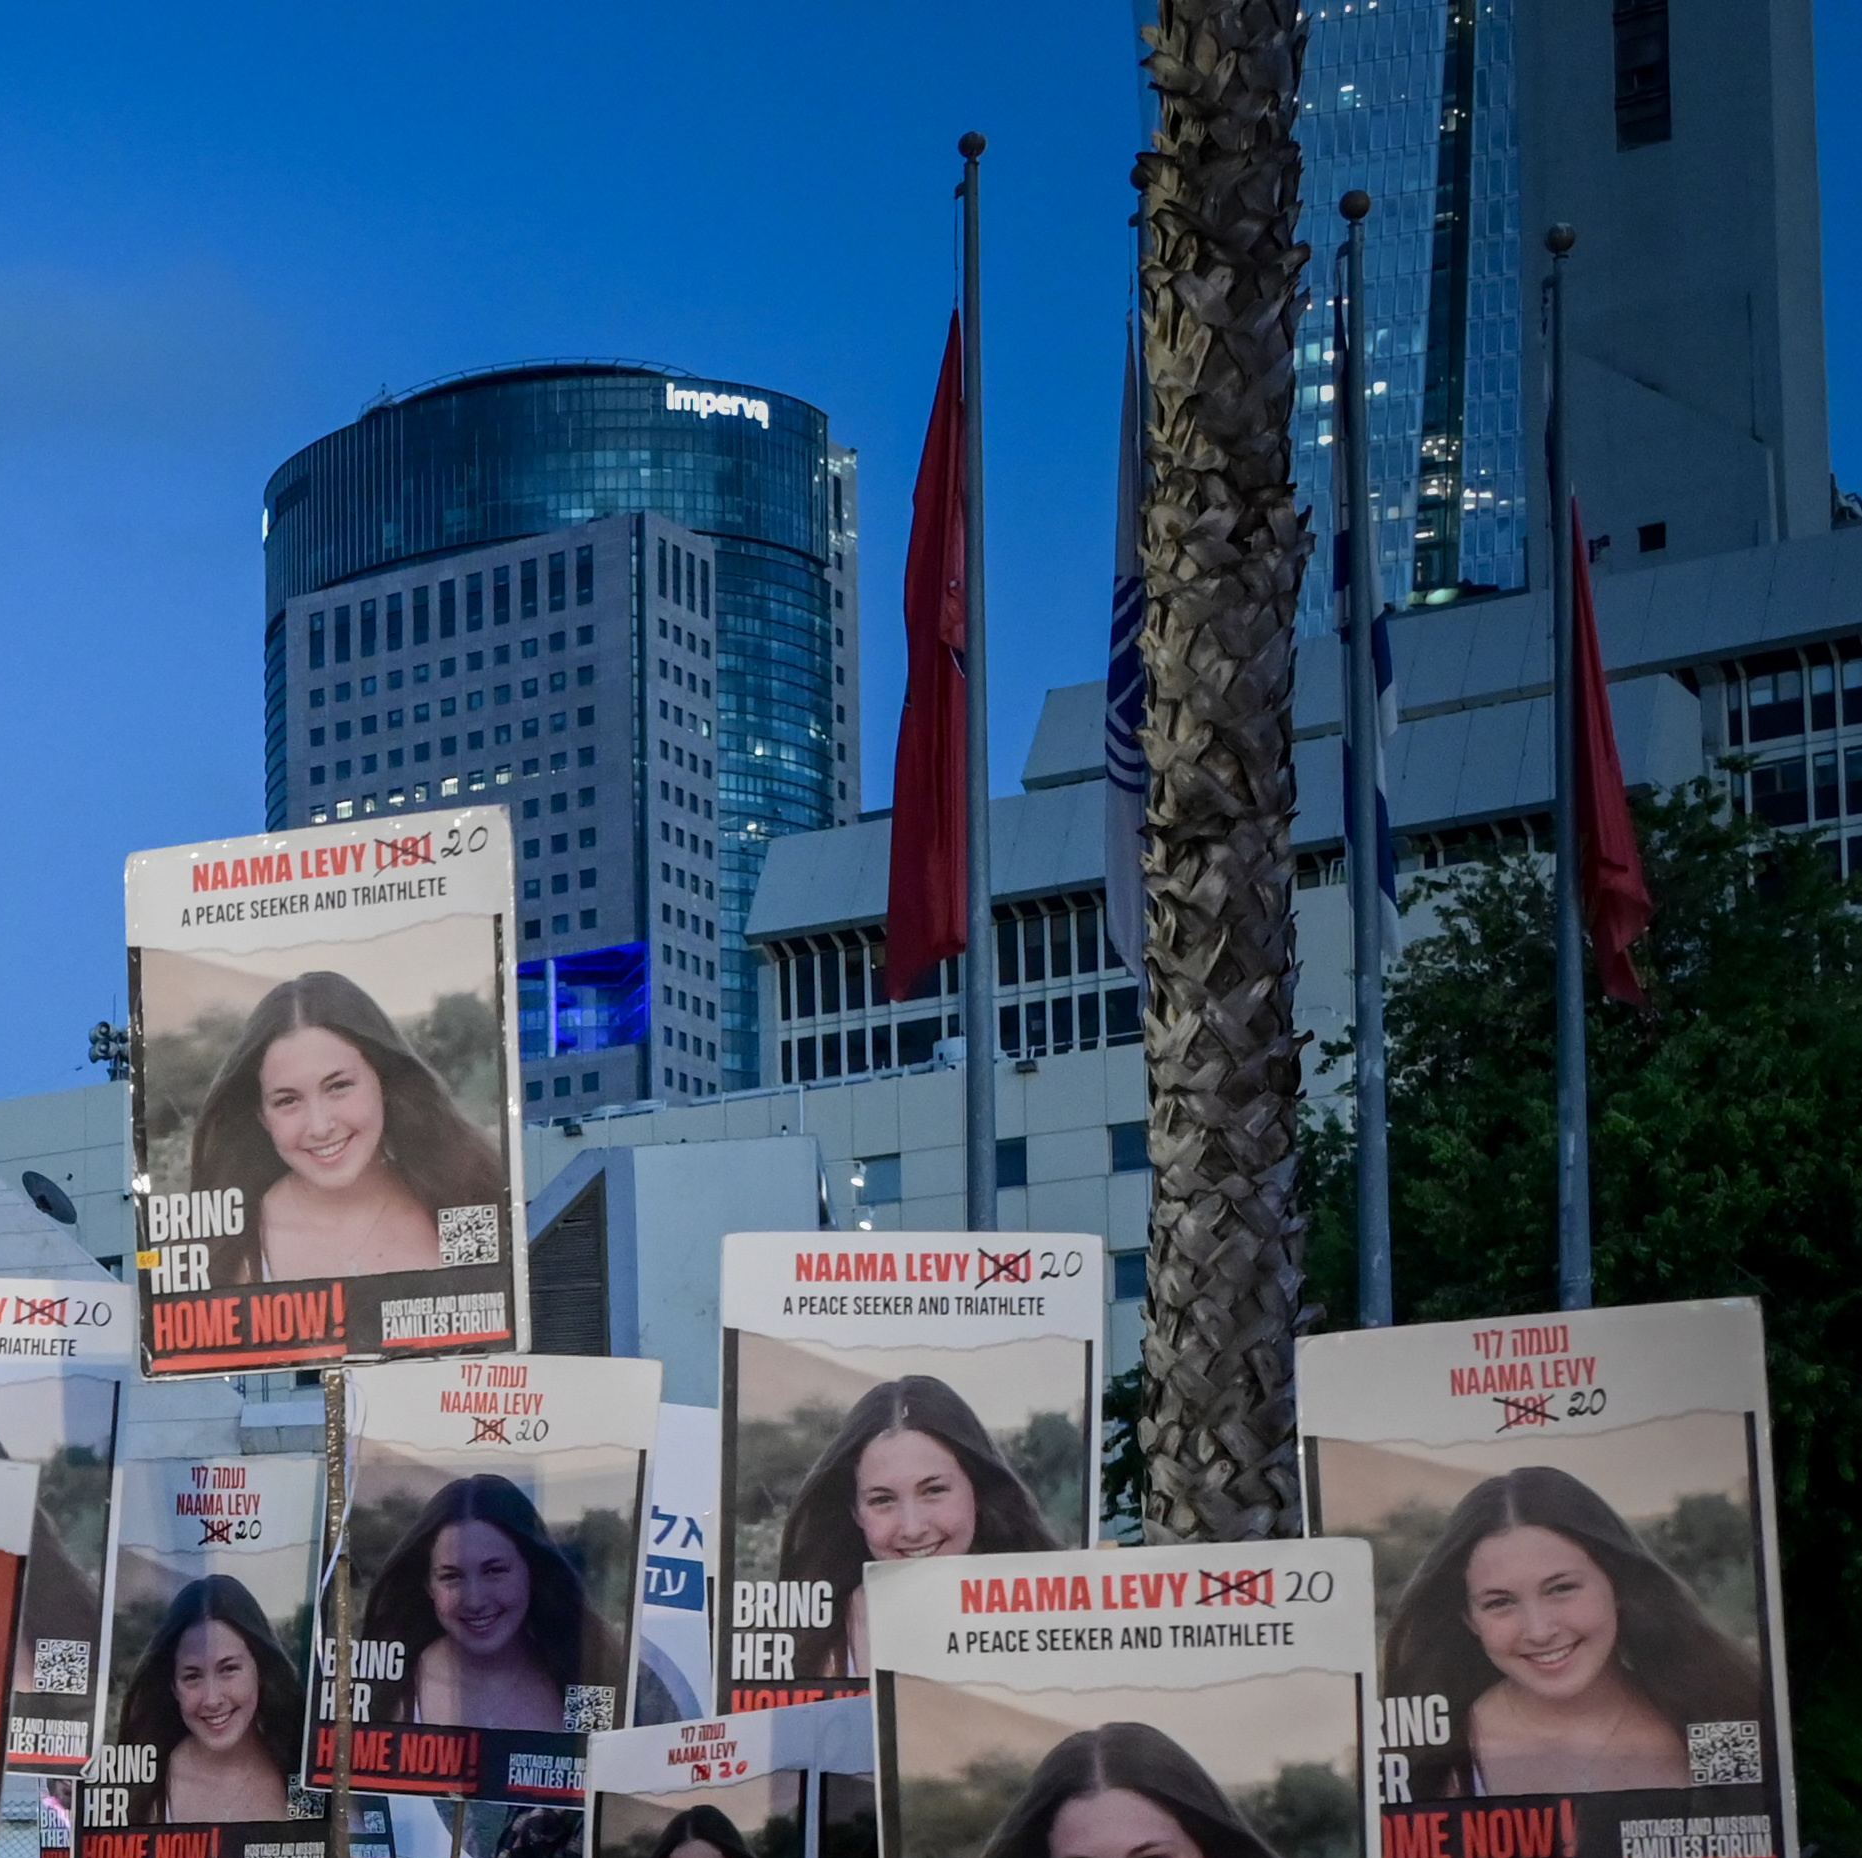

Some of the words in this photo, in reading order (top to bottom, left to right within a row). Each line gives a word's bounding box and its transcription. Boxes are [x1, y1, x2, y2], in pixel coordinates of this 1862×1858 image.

[666, 382, 769, 429] Imperva
[192, 857, 292, 892] NAAMA
[301, 843, 366, 879] LEVY
[441, 826, 488, 857] 20
[181, 907, 191, 928] A
[196, 900, 245, 925] PEACE
[250, 894, 308, 920] SEEKER
[314, 889, 346, 913] AND
[352, 877, 446, 907] TRIATHLETE
[149, 1187, 243, 1242] BRING
[151, 1242, 209, 1294] HER
[796, 1253, 898, 1282] NAAMA
[906, 1253, 969, 1282] LEVY
[1040, 1251, 1083, 1280] 20
[152, 1296, 241, 1351] HOME
[251, 1283, 346, 1344] NOW!
[381, 1298, 433, 1317] HOSTAGES
[784, 1297, 793, 1315] A
[798, 1297, 848, 1315] PEACE
[853, 1297, 914, 1316] SEEKER
[918, 1297, 950, 1316] AND
[956, 1297, 1045, 1316] TRIATHLETE
[382, 1313, 449, 1342] FAMILIES
[452, 1309, 506, 1335] FORUM
[1512, 1325, 1569, 1354] נעמה
[1450, 1363, 1535, 1397] NAAMA
[1541, 1356, 1596, 1390] LEVY
[441, 1390, 498, 1414] NAAMA
[504, 1390, 543, 1415] LEVY
[1568, 1388, 1607, 1419] 20
[176, 1493, 223, 1517] NAAMA
[227, 1492, 261, 1517] LEVY
[733, 1581, 833, 1629] BRING
[960, 1574, 1089, 1614] NAAMA
[1102, 1572, 1189, 1612] LEVY
[1284, 1569, 1333, 1603] 20
[947, 1632, 959, 1654] A
[967, 1630, 1030, 1653] PEACE
[1037, 1627, 1113, 1652] SEEKER
[1120, 1626, 1163, 1650] AND
[1169, 1621, 1294, 1649] TRIATHLETE
[732, 1632, 795, 1681] HER
[37, 1733, 87, 1758] FORUM
[668, 1746, 707, 1766] NAAMA
[710, 1741, 736, 1760] LEVY
[84, 1786, 128, 1828] HER
[1620, 1819, 1684, 1837] HOSTAGES
